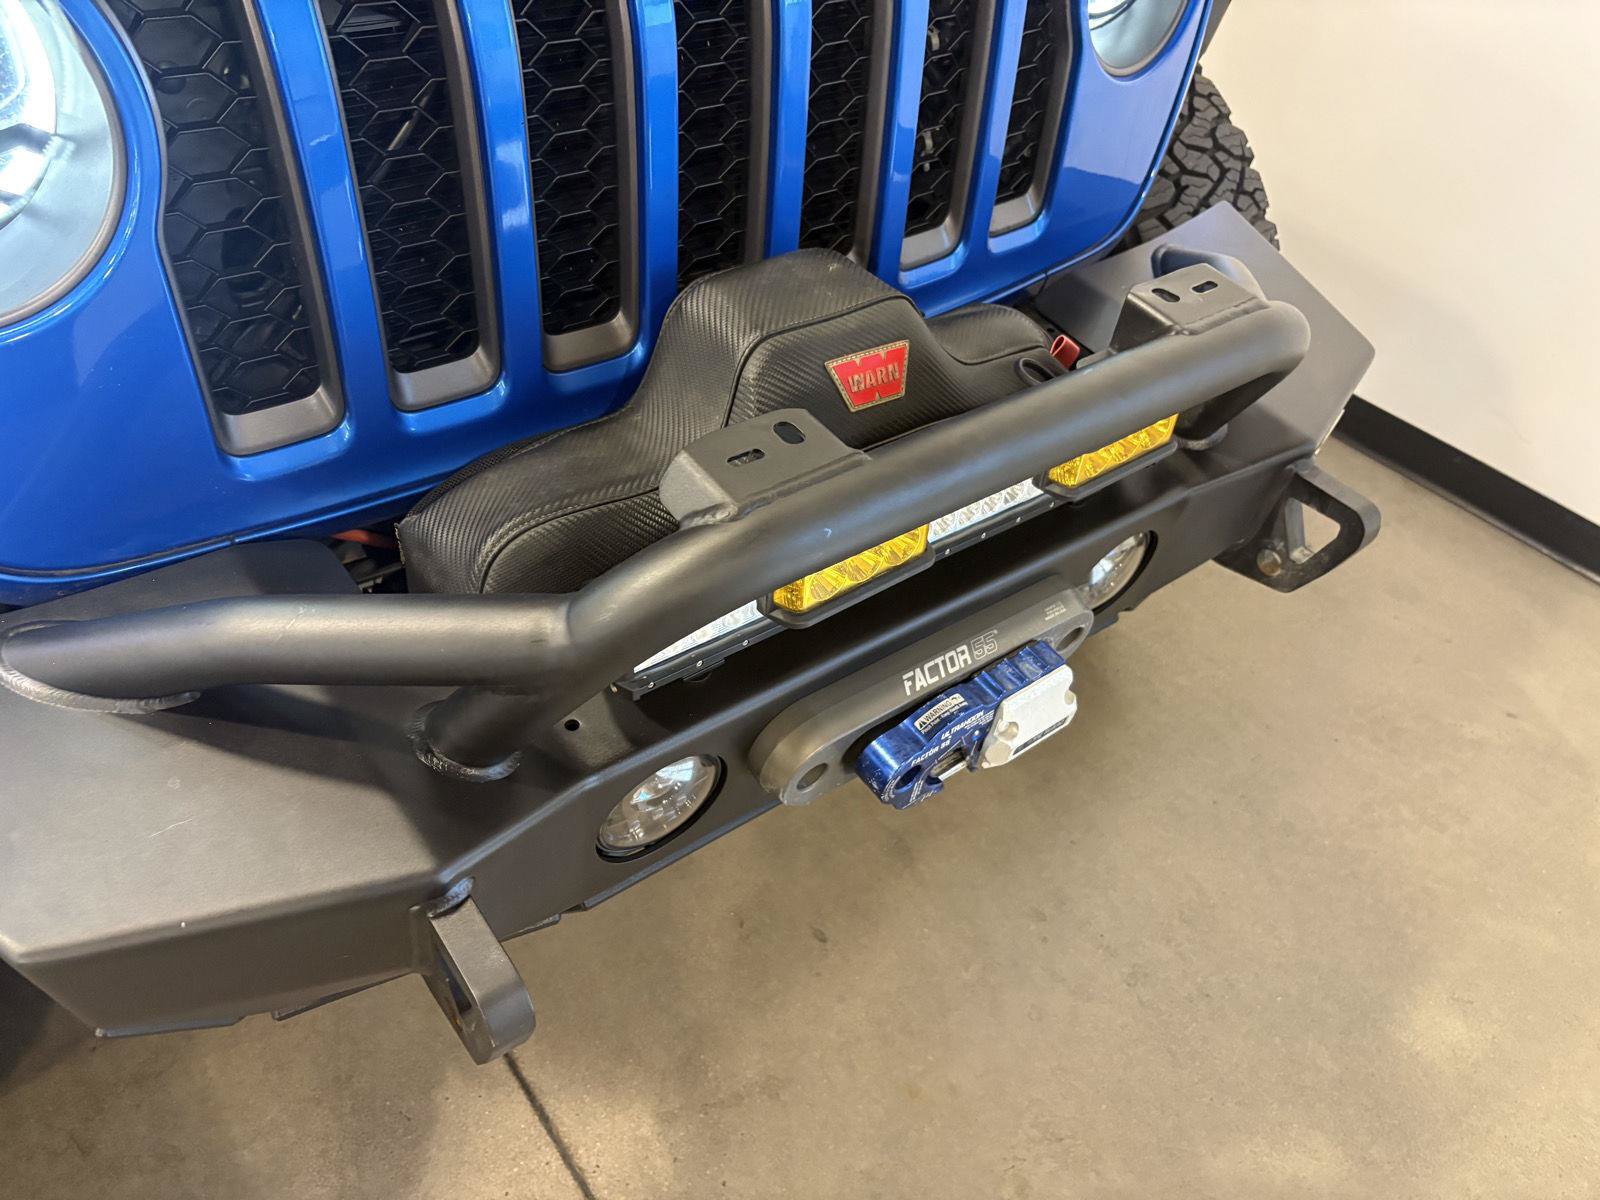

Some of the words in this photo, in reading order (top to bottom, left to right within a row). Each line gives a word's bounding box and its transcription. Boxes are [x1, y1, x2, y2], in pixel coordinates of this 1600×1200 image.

[848, 362, 900, 393] WARN
[902, 644, 972, 696] FACTOR
[971, 630, 998, 660] 55
[923, 700, 953, 722] WARNING
[911, 746, 939, 766] FACTOR
